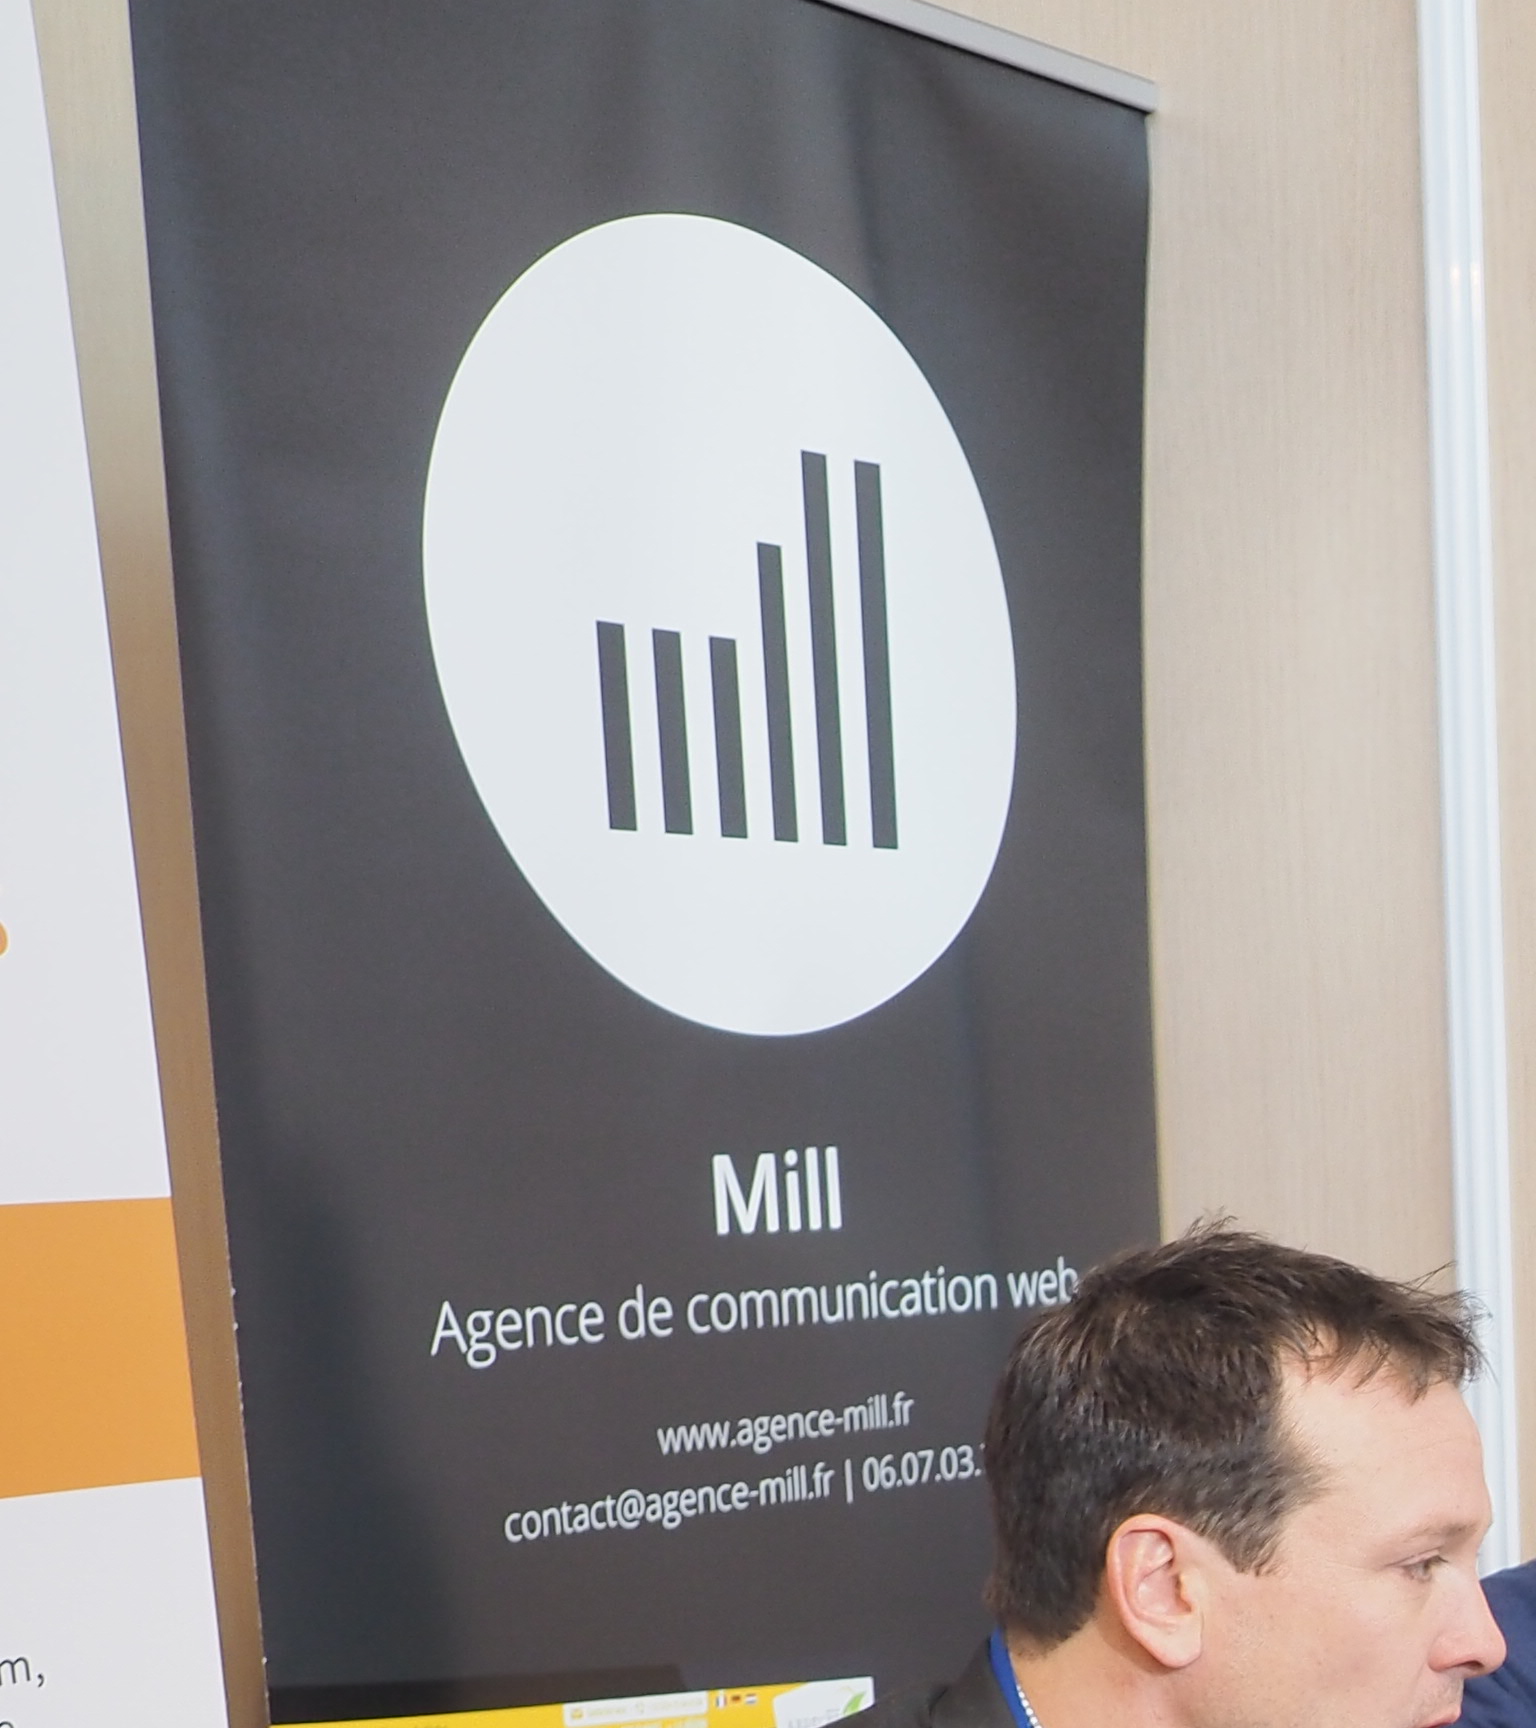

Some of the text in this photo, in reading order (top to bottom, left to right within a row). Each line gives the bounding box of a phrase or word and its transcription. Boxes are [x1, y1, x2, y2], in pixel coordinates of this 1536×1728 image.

[712, 1146, 842, 1235] Mill
[430, 1257, 1078, 1369] Agence de communication web
[657, 1391, 913, 1455] www.agence-mill.fr
[505, 1464, 833, 1542] contact@agence-mill.fr
[862, 1442, 987, 1491] 06.07.03.
